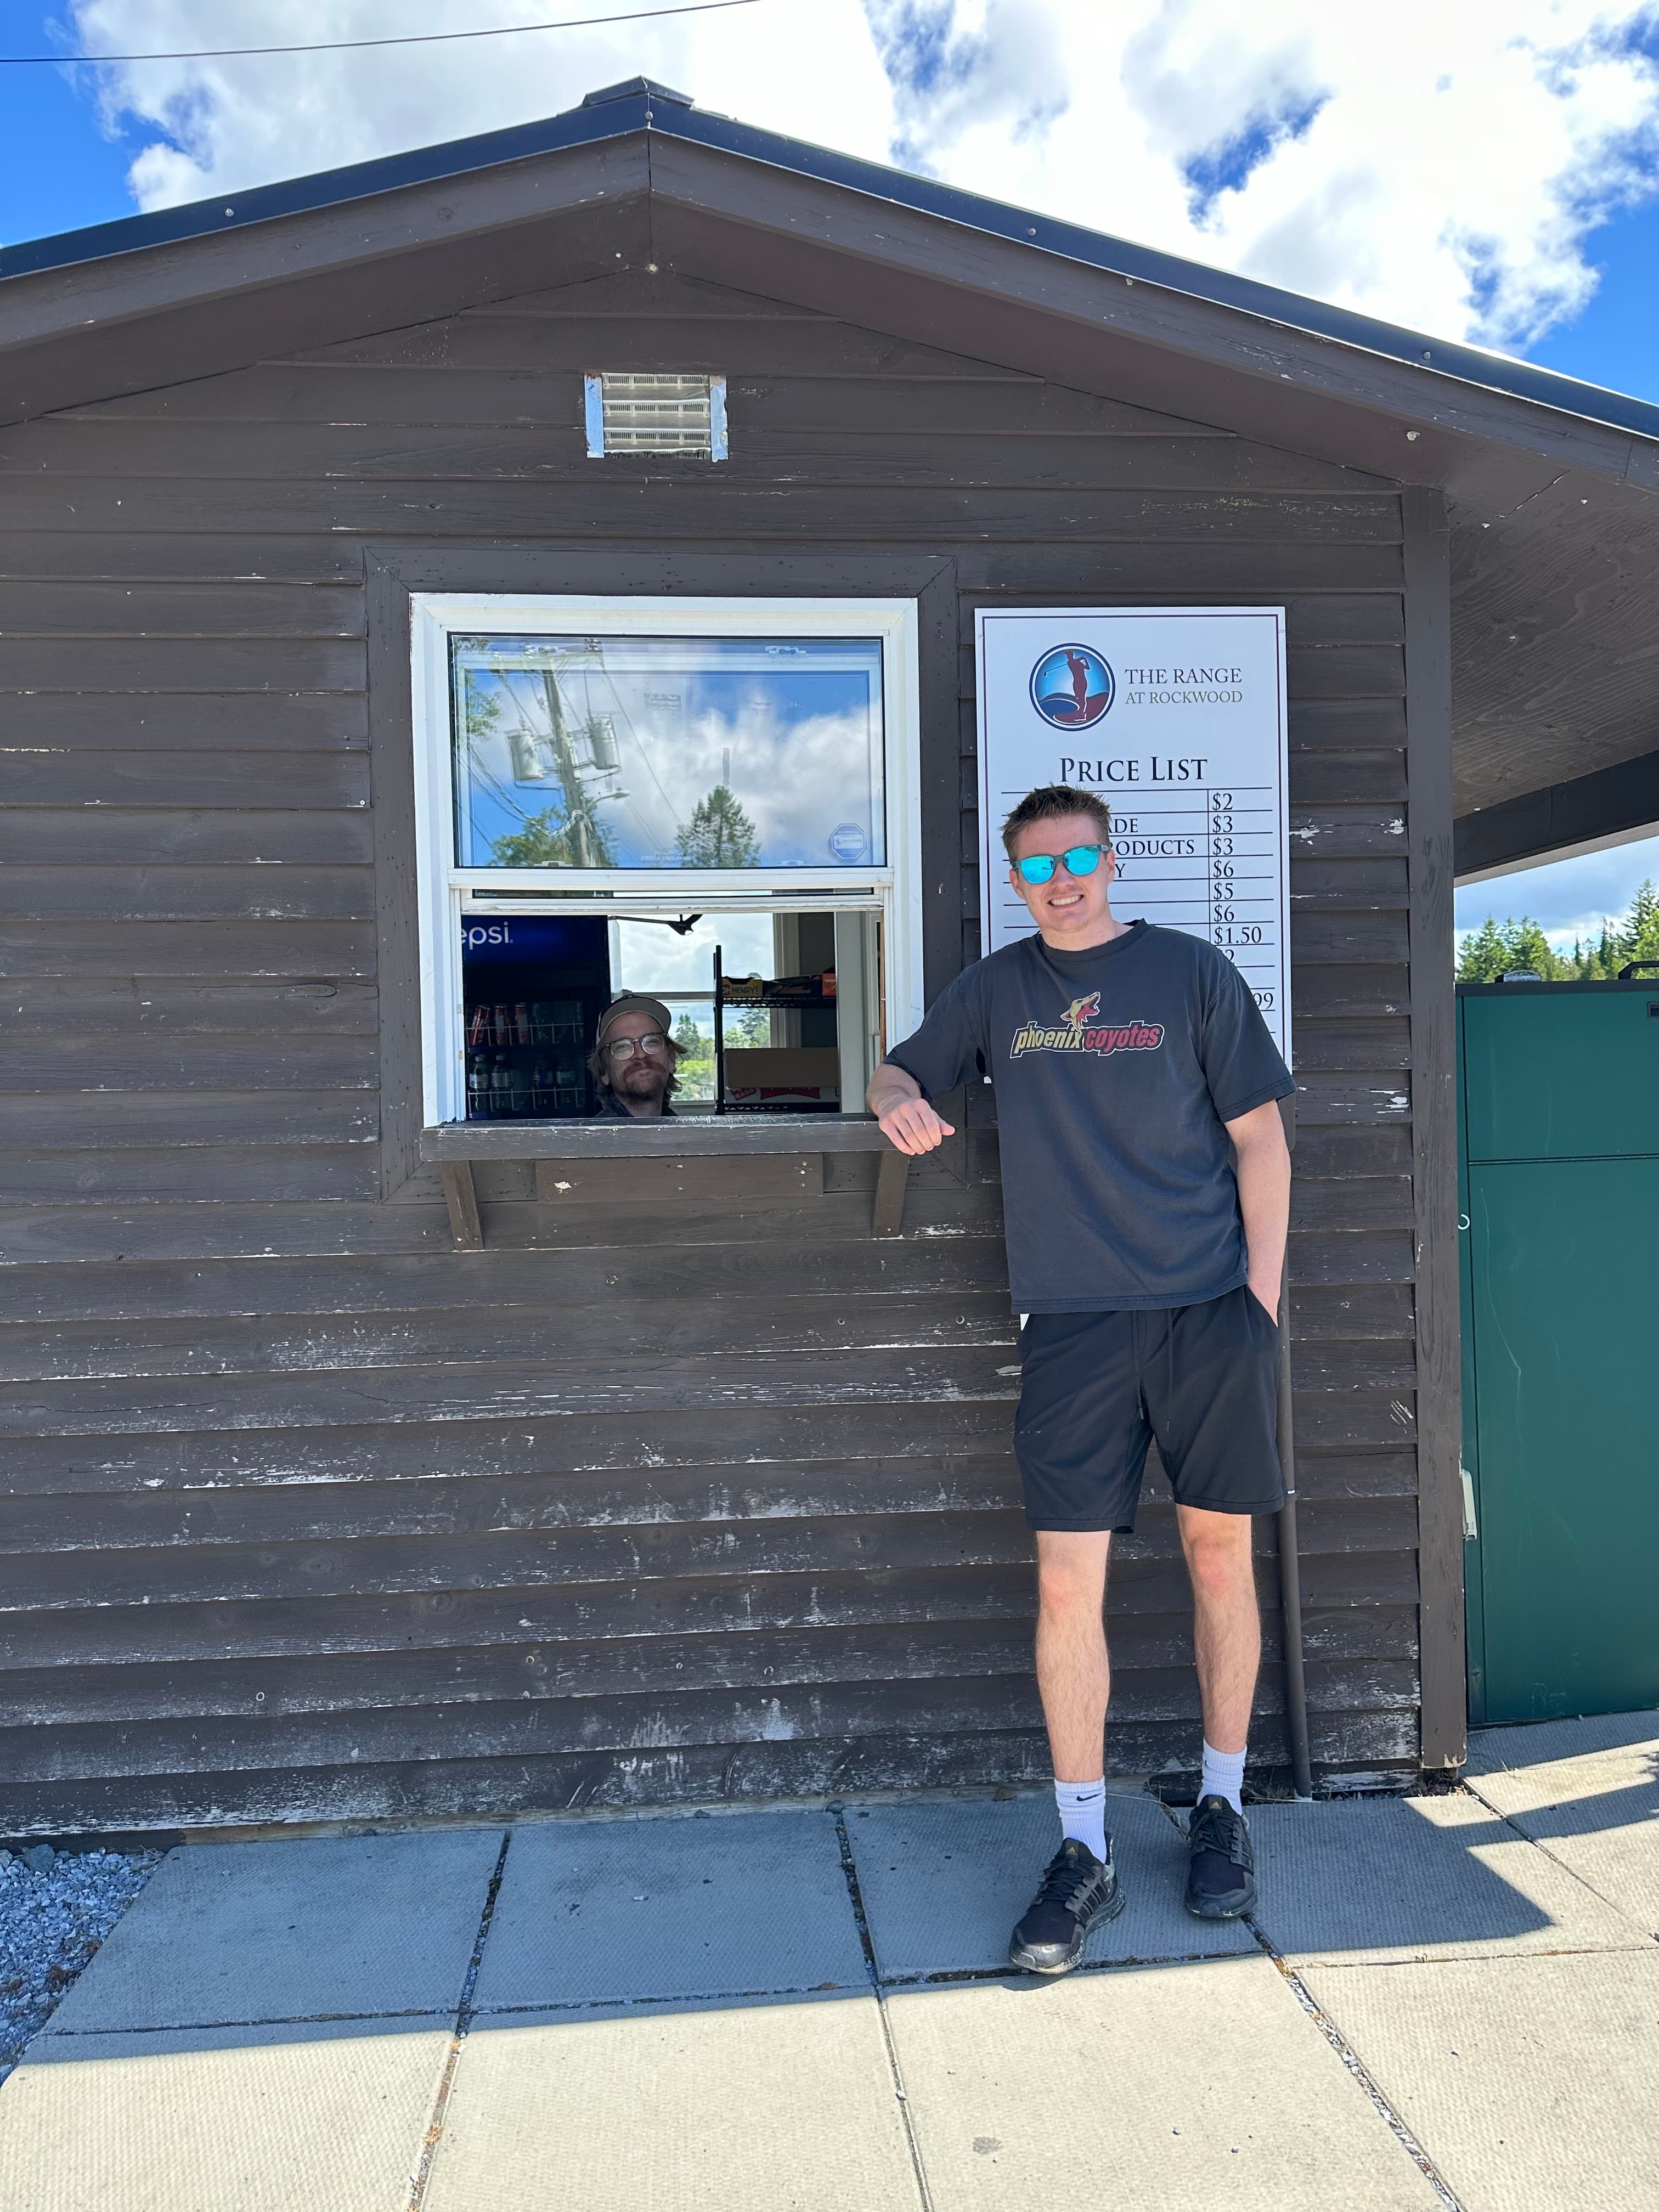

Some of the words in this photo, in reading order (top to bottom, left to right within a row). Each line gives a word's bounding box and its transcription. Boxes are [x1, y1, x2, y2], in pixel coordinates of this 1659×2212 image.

[1125, 668, 1166, 684] THE
[1173, 668, 1243, 684] RANGE
[1125, 692, 1146, 704] AT
[1149, 691, 1243, 704] ROCKWOOD
[1060, 757, 1139, 782] PRICE
[1150, 756, 1208, 781] LIST
[1212, 792, 1233, 811] $2
[1212, 815, 1233, 834] $3
[1110, 839, 1194, 856] ODUCTS
[1213, 838, 1233, 856] $3
[1213, 860, 1234, 879] $6
[1214, 882, 1234, 901] $5
[1214, 904, 1234, 924] $6
[1214, 926, 1262, 945] $1.50
[732, 986, 758, 995] HENRY!
[1013, 1024, 1083, 1055] phoenix
[1085, 1024, 1160, 1053] coyotes
